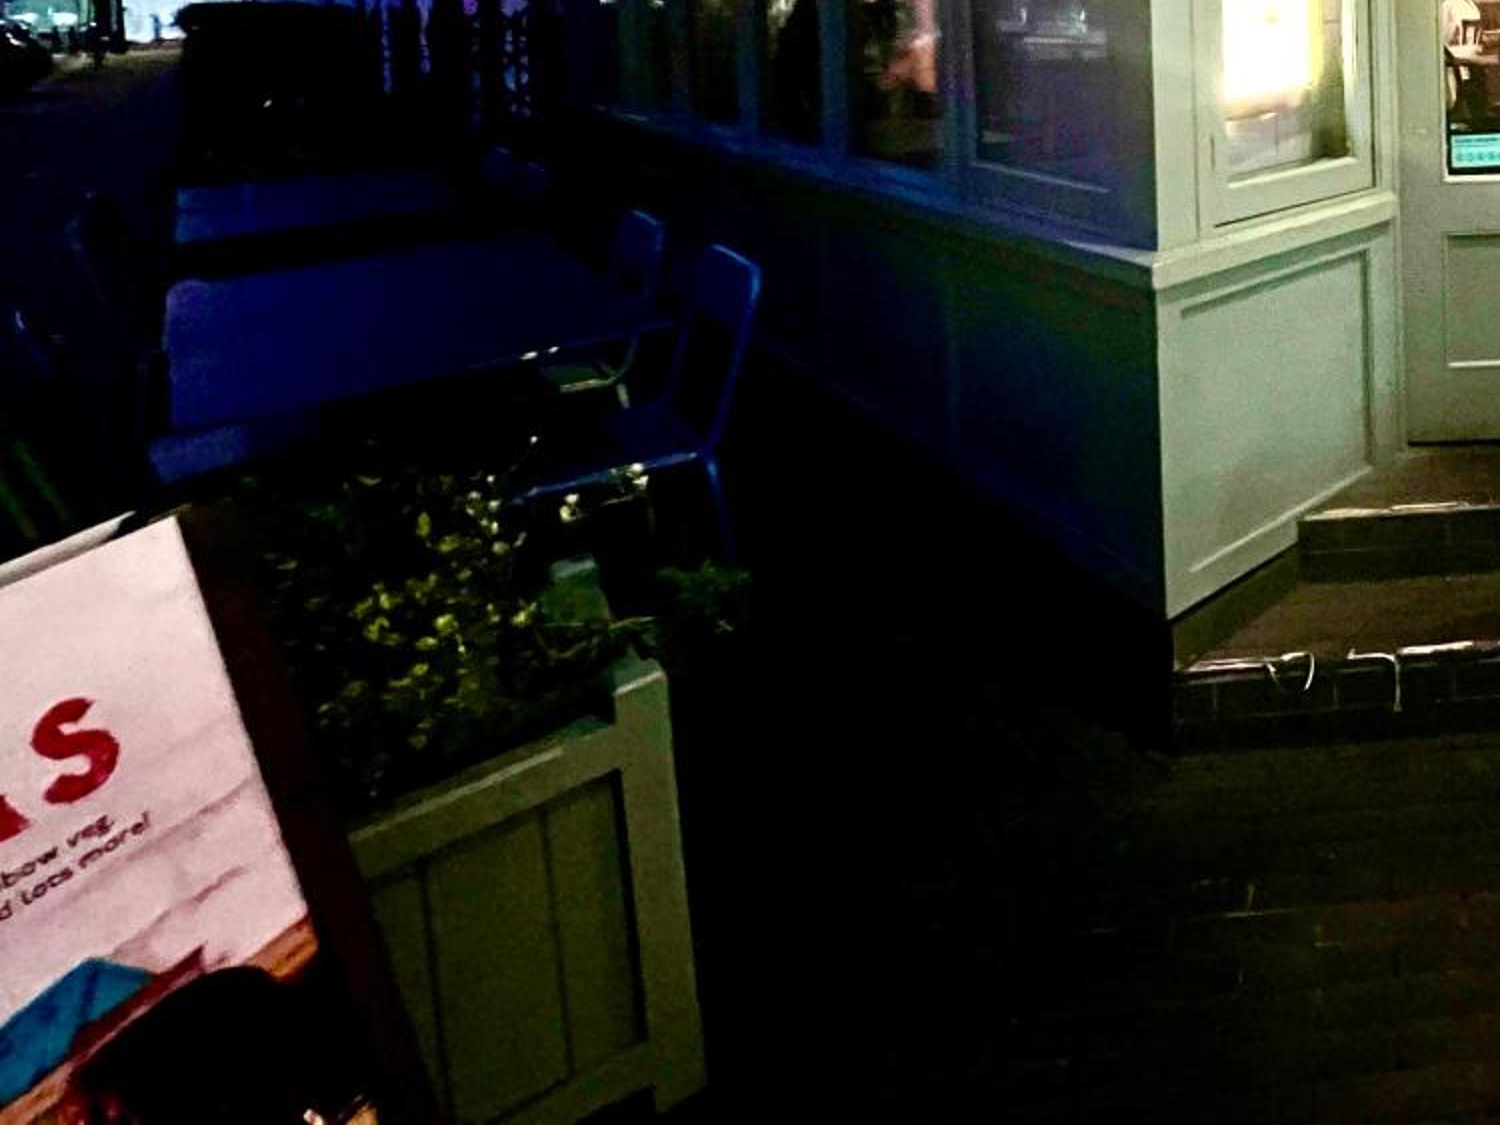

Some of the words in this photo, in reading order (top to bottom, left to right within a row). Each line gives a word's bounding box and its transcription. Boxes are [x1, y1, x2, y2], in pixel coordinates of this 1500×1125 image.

[0, 698, 119, 842] S
[21, 867, 74, 905] lots
[78, 811, 151, 869] more!
[66, 815, 115, 848] veg
